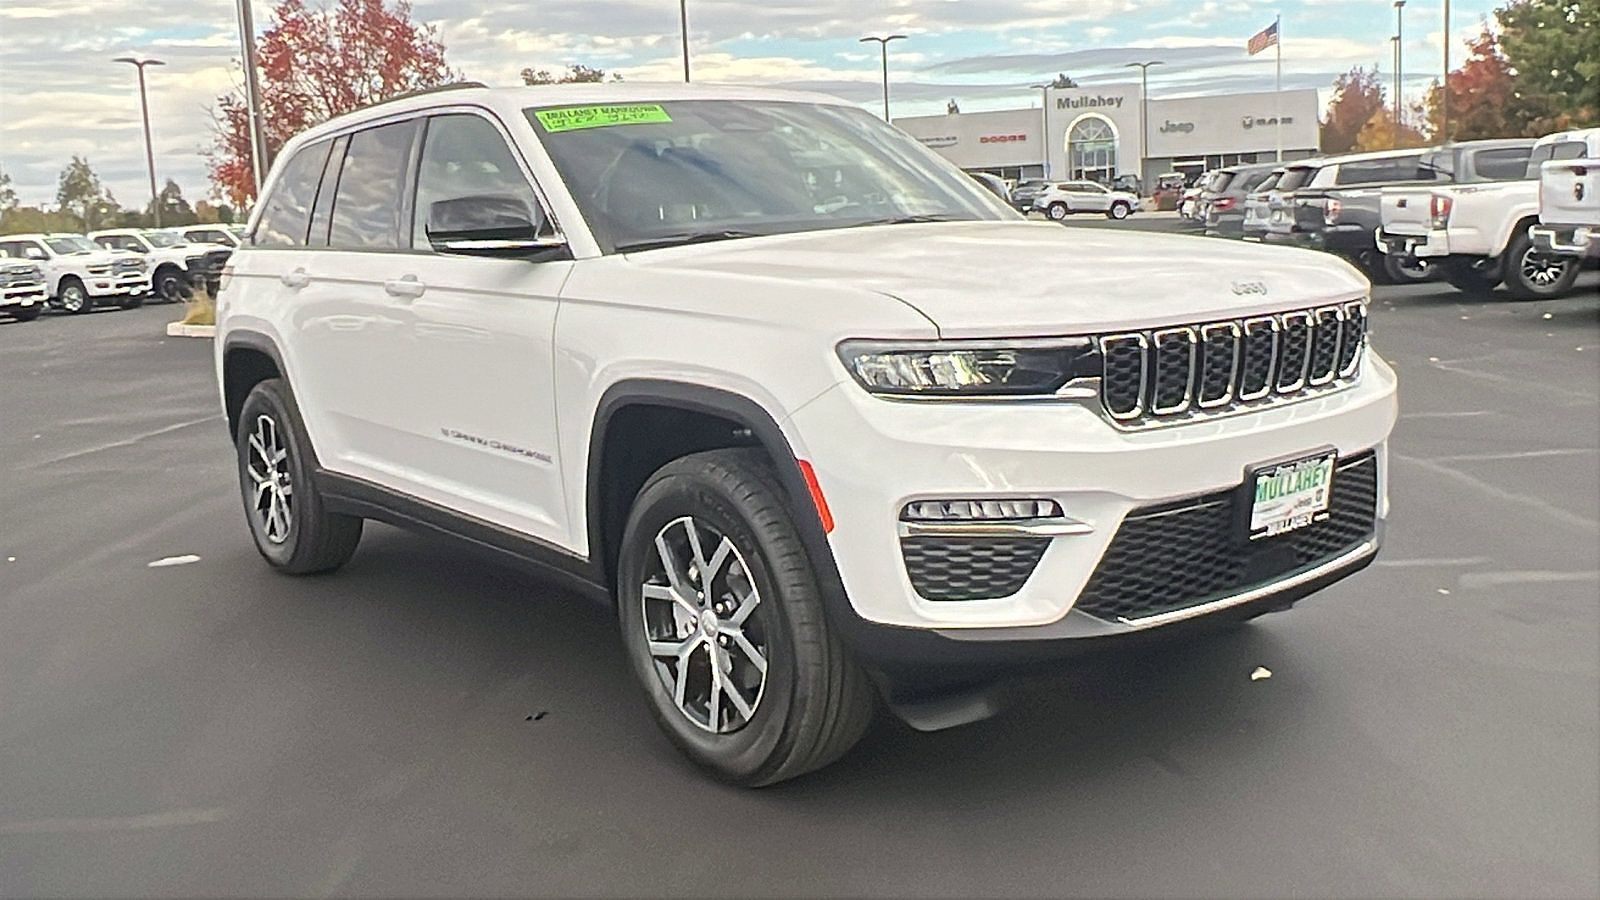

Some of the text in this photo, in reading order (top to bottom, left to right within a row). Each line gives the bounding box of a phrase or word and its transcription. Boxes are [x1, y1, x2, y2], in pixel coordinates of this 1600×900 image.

[1056, 95, 1124, 110] Mullahey
[1159, 120, 1195, 134] Jeep
[979, 133, 1027, 144] DODGE
[1230, 280, 1268, 296] Jeep
[1256, 463, 1330, 502] MULLAHEY
